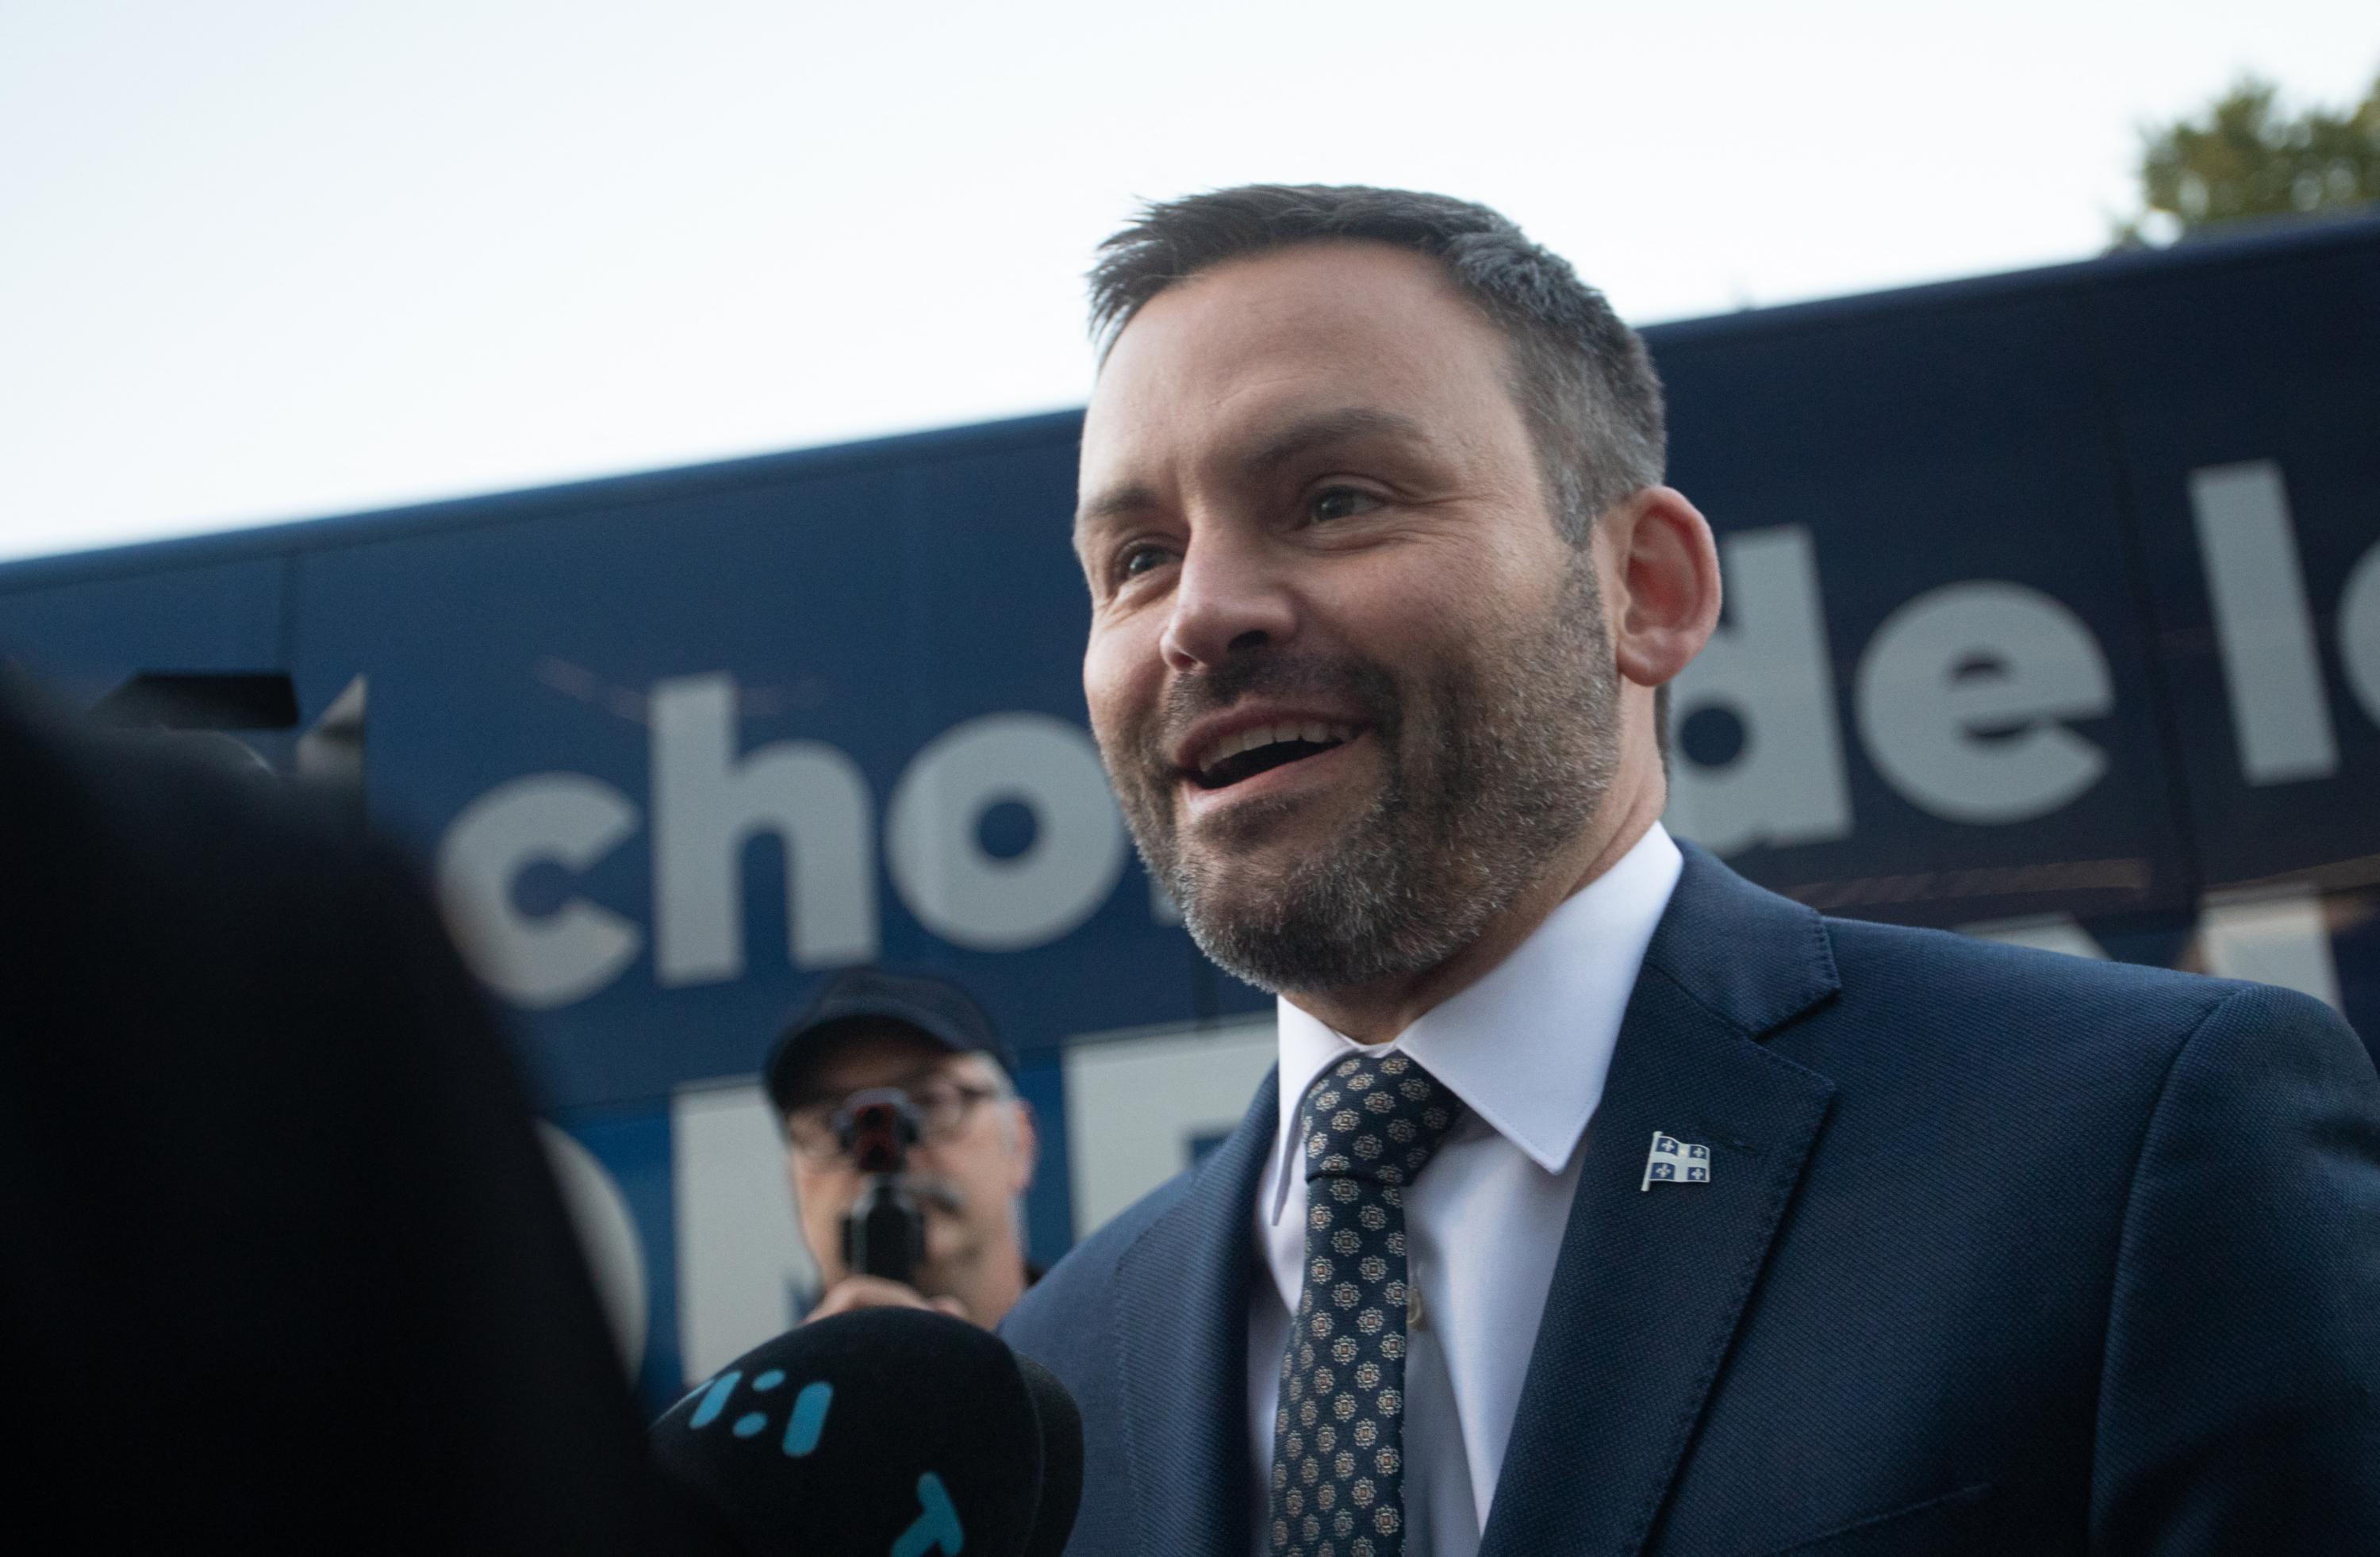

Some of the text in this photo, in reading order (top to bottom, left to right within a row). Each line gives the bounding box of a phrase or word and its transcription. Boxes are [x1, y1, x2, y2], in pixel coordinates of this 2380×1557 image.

[436, 458, 2380, 1009] cho de l
